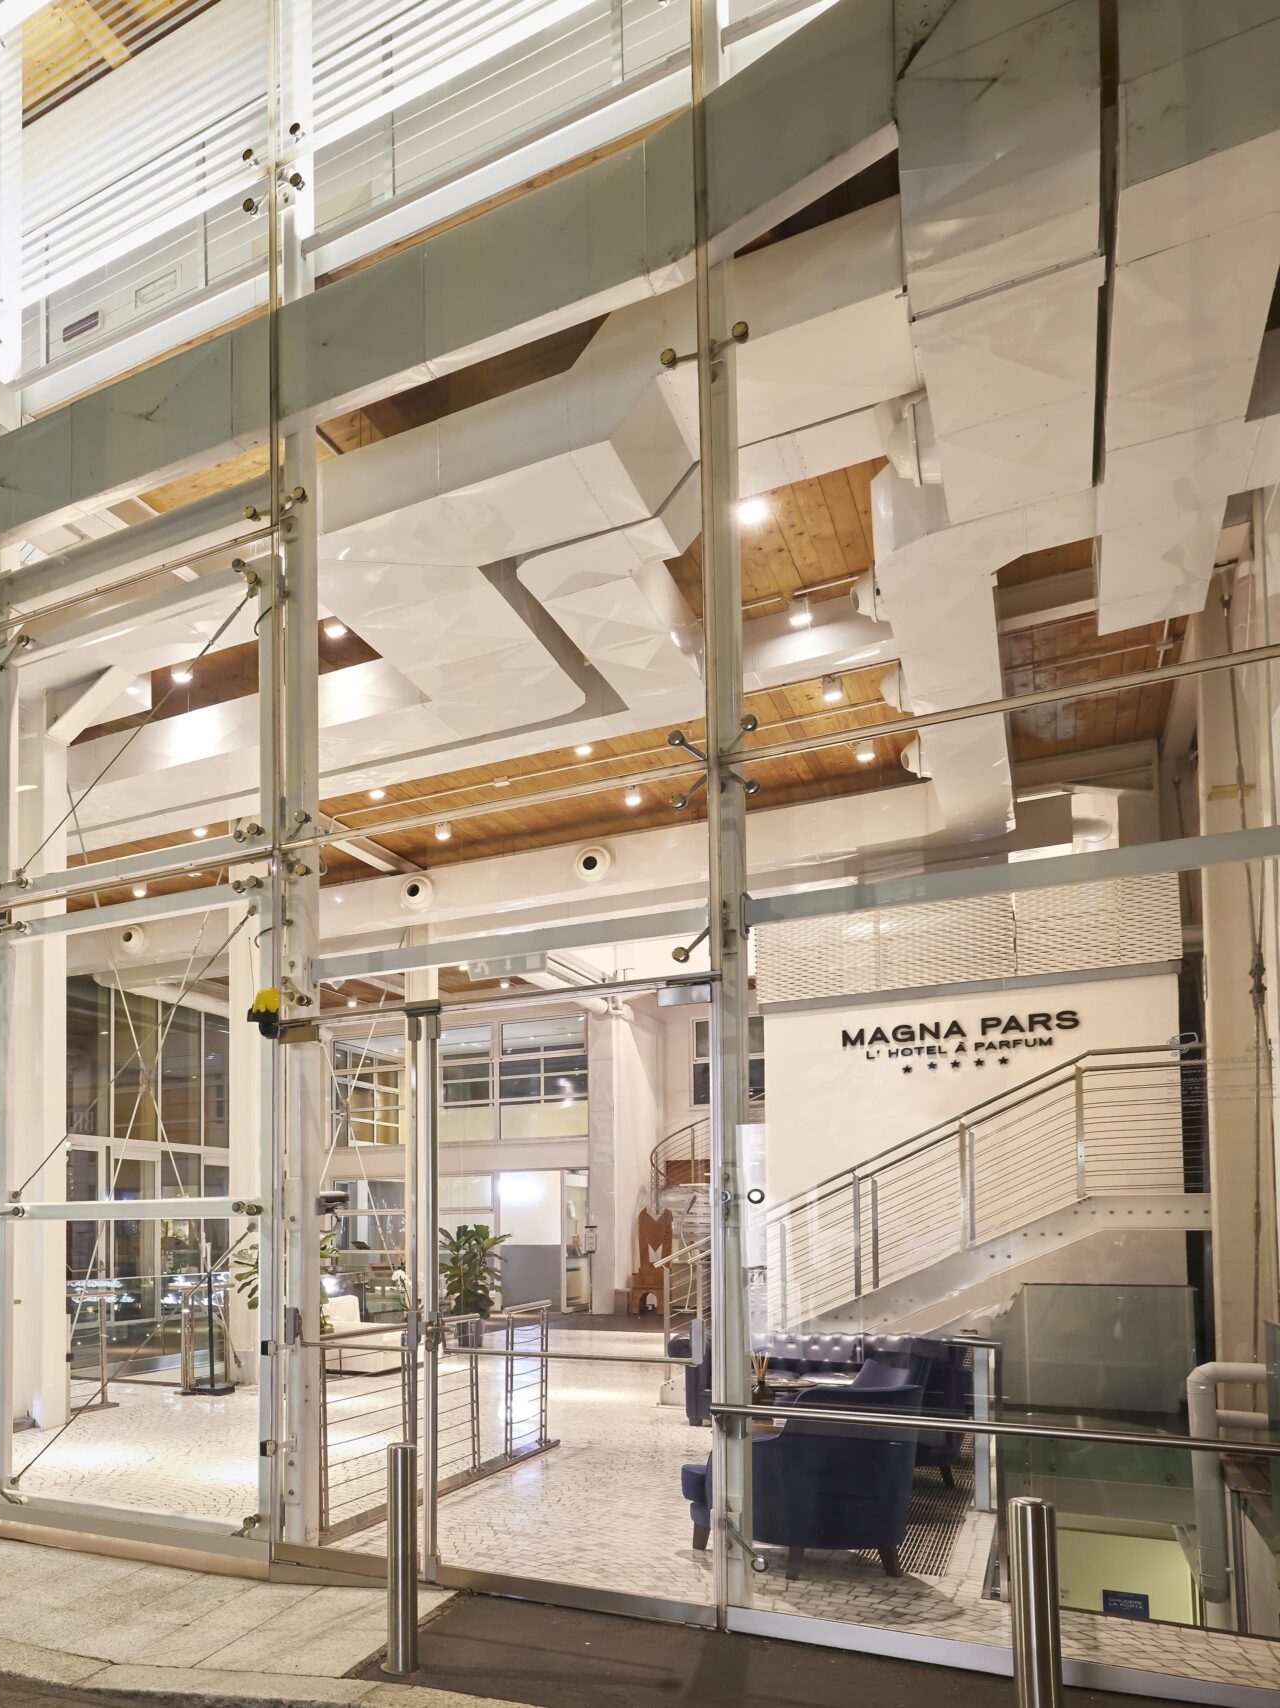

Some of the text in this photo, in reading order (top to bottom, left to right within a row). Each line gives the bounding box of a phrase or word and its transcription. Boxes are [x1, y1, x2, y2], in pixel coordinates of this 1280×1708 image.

[841, 1010, 1080, 1048] MAGNA PARS
[888, 1045, 948, 1058] HOTEL
[955, 1041, 966, 1053] À
[974, 1037, 1054, 1052] PARFUM
